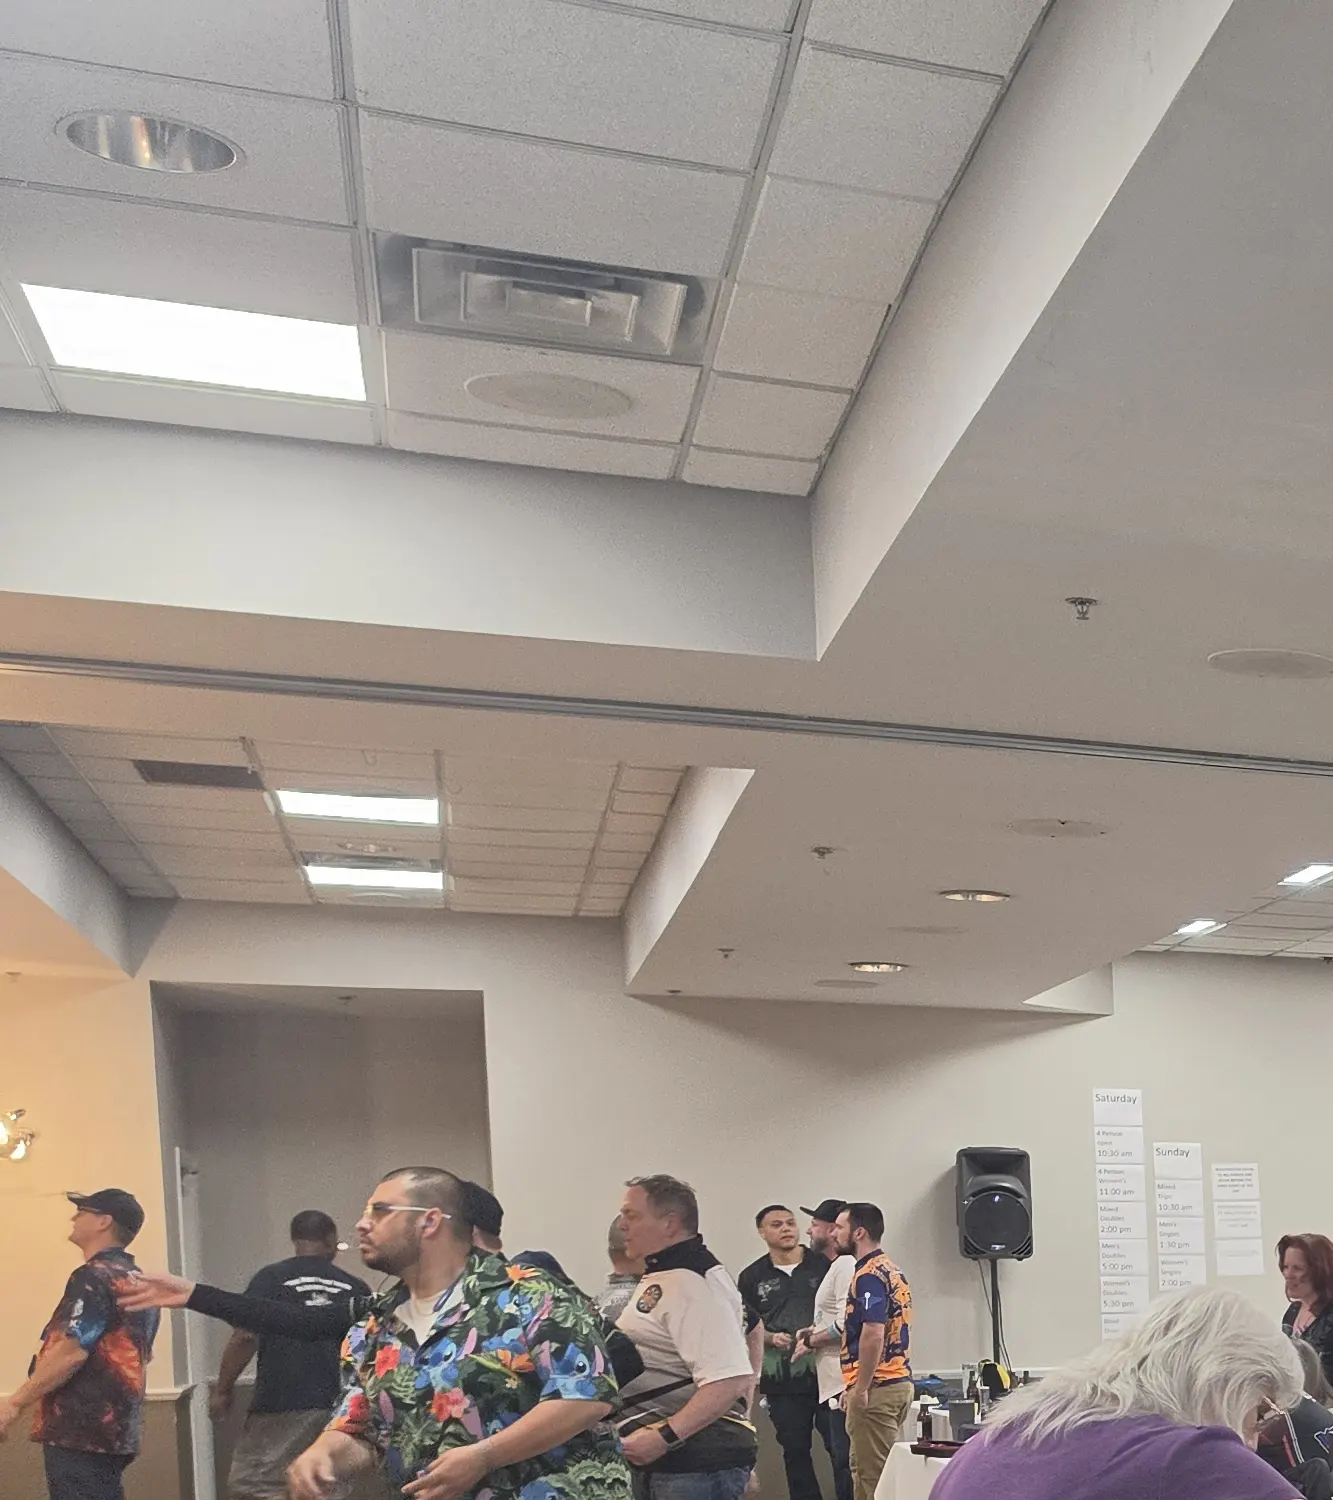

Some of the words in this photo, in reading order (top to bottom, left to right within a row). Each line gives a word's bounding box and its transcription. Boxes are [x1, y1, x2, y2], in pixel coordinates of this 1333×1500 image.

[1095, 1093, 1137, 1105] Saturday
[1155, 1147, 1190, 1158] Sunday
[1101, 1225, 1117, 1233] 2:00
[1102, 1262, 1119, 1270] 5:00
[1120, 1263, 1133, 1271] pm
[1161, 1279, 1178, 1287] 2:00
[1103, 1300, 1120, 1308] 5:30
